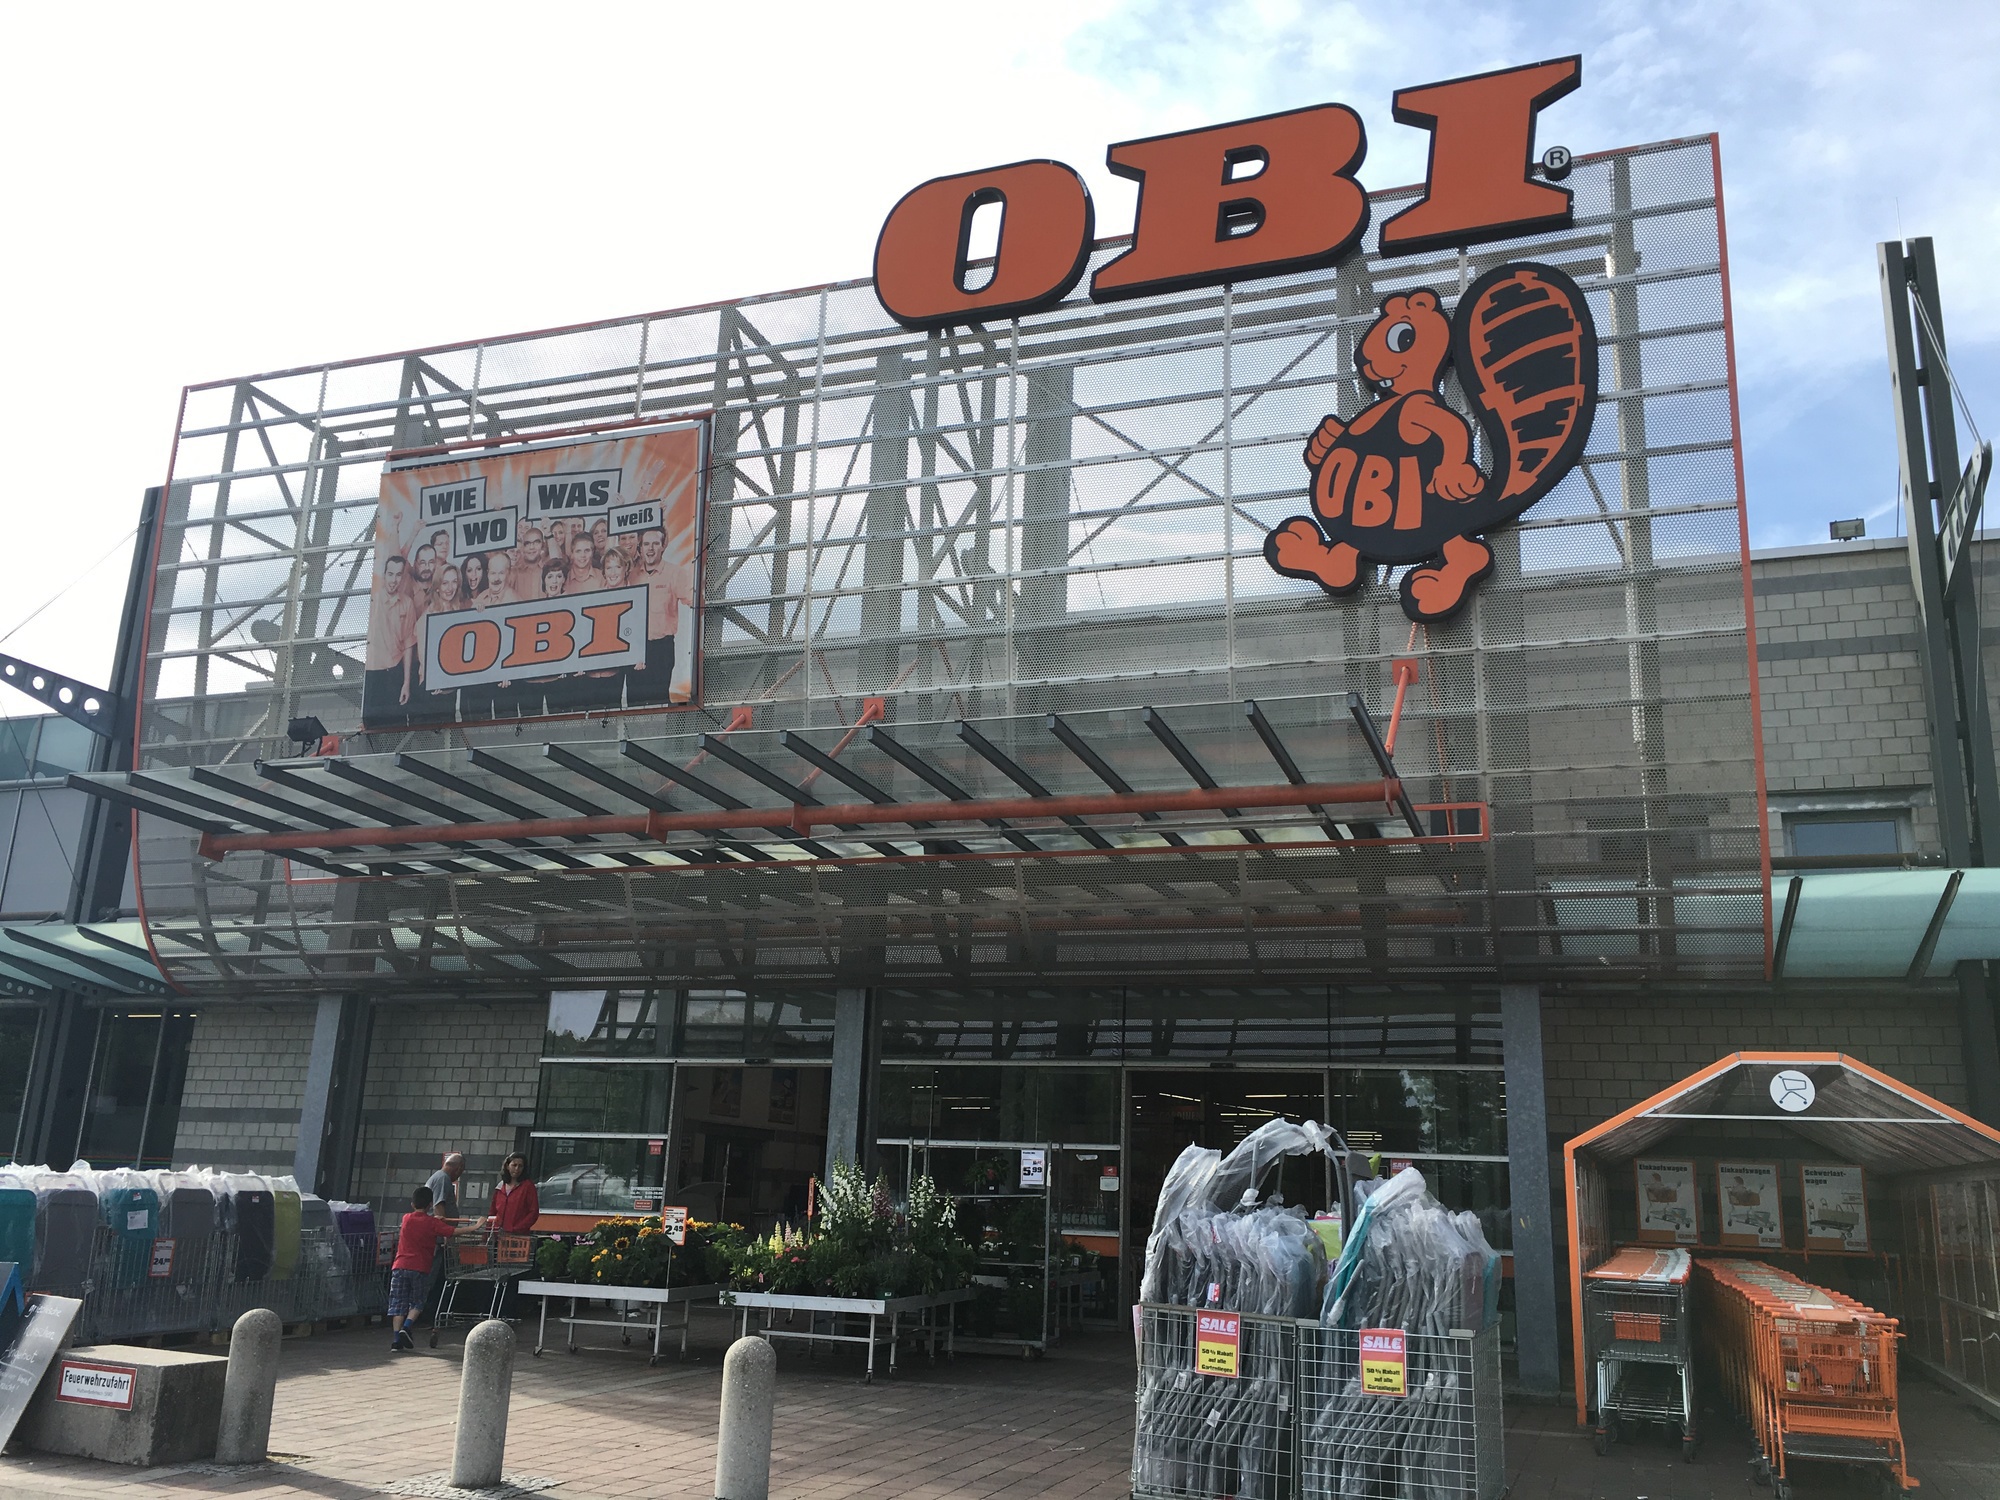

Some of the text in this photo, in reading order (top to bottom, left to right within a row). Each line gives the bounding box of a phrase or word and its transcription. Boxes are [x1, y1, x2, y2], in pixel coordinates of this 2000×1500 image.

[873, 54, 1582, 331] OBI
[537, 480, 610, 510] WAS
[1316, 449, 1424, 532] OBI
[428, 487, 477, 517] WIE
[616, 508, 654, 527] weiß
[463, 517, 508, 547] WO
[438, 600, 634, 676] OBI
[1638, 1163, 1688, 1173] Einkaufswagen
[1720, 1166, 1771, 1175] Einkaufswagen
[1805, 1178, 1828, 1186] wagen
[1050, 1212, 1107, 1225] ENGANG
[1200, 1317, 1237, 1333] SALE
[1362, 1335, 1402, 1350] SALE
[64, 1370, 130, 1391] Feuerwehrzufahrt
